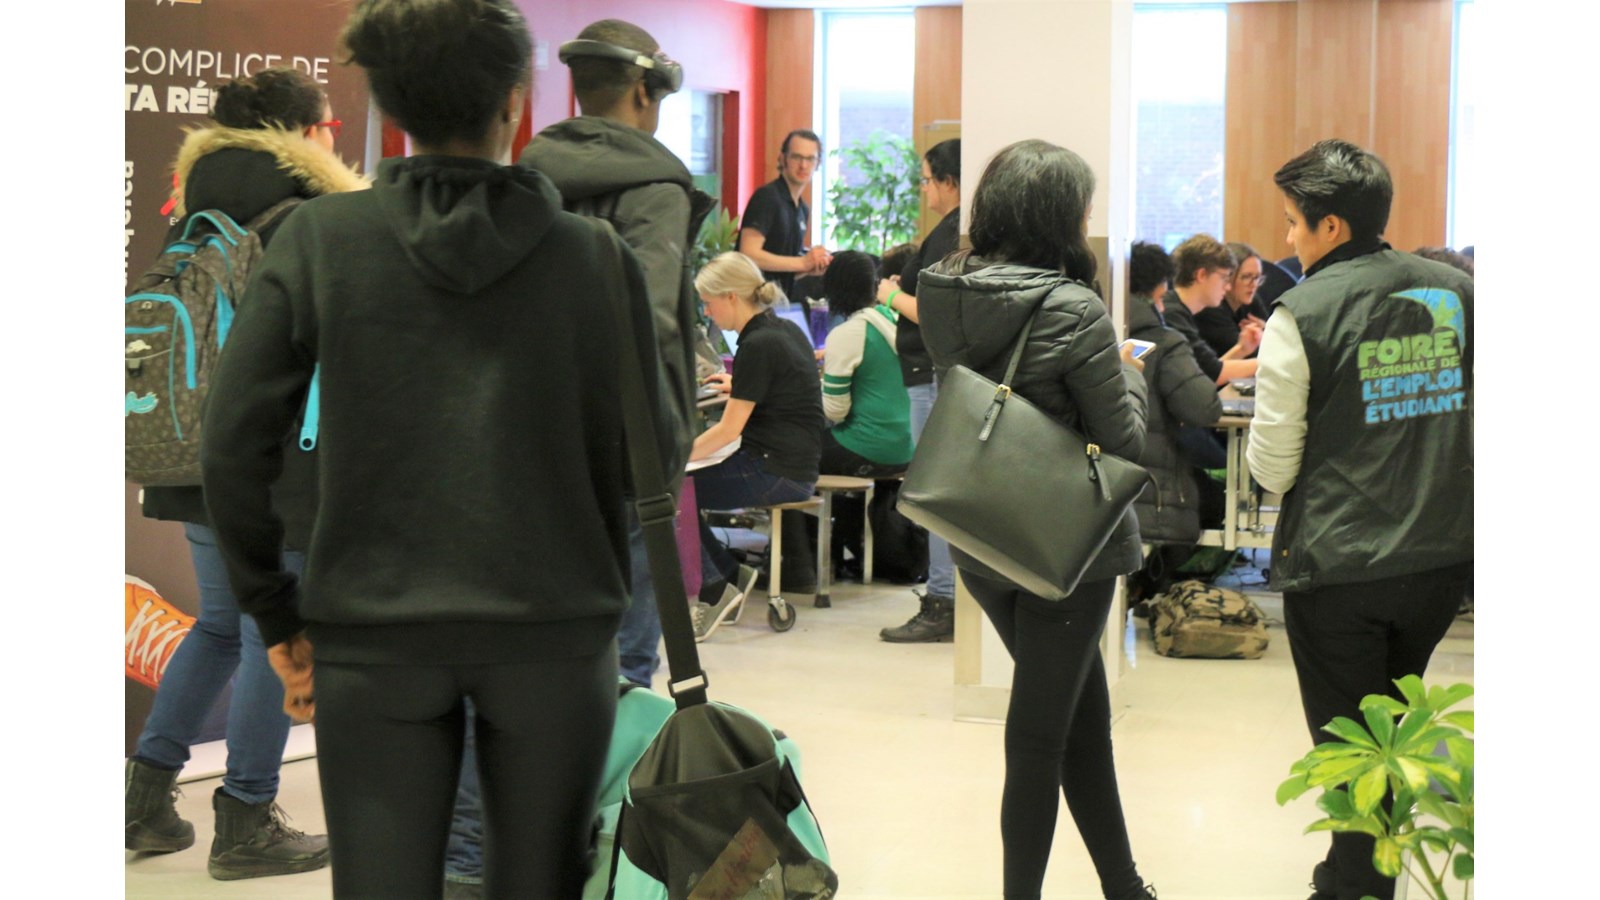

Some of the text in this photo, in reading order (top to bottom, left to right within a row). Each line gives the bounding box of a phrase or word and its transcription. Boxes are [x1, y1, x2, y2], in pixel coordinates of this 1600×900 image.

[293, 55, 330, 84] DE
[125, 83, 160, 112] TA
[1358, 331, 1456, 368] FOIRE
[1360, 356, 1460, 380] RÉGIONALE DE
[1363, 368, 1462, 402] L'EMPLOI
[1366, 392, 1465, 424] ÉTUDIANT
